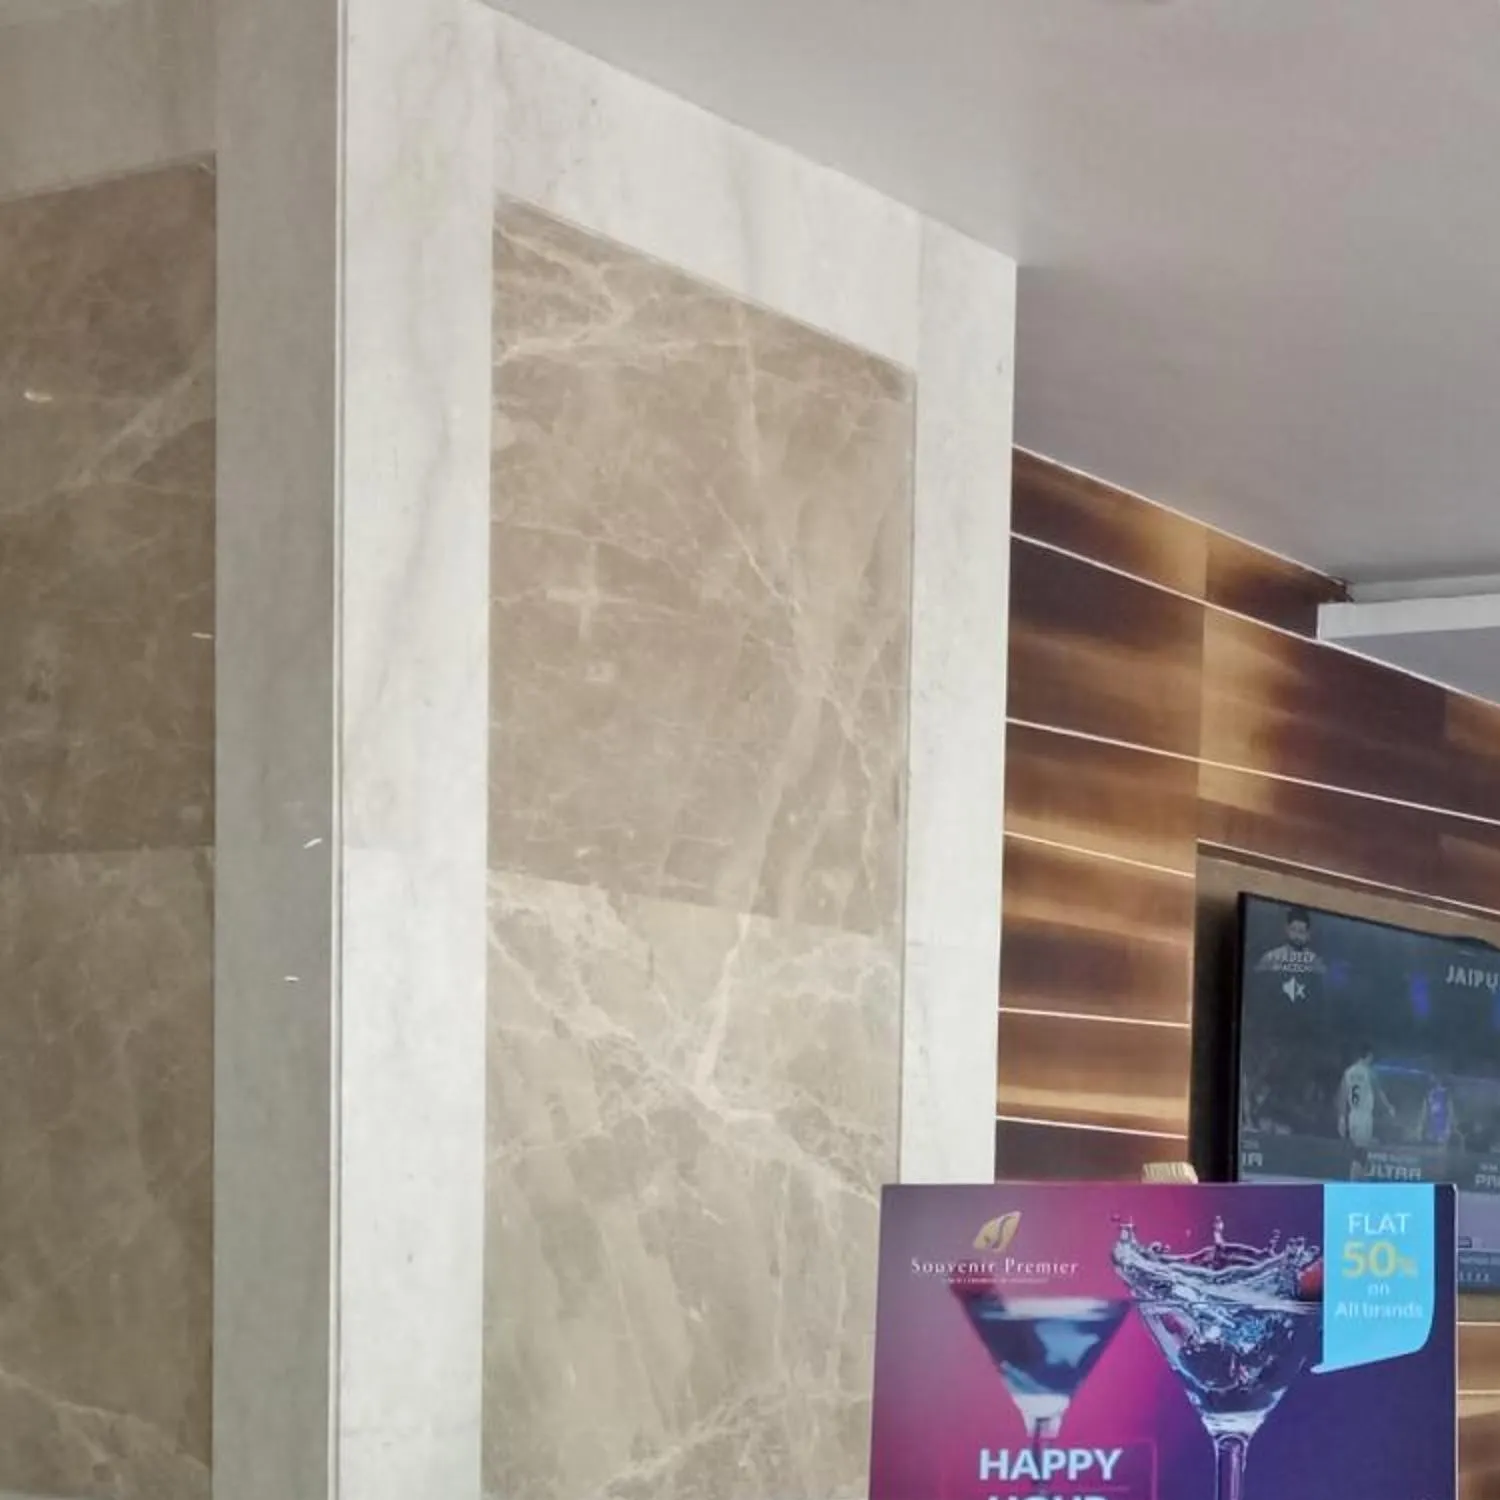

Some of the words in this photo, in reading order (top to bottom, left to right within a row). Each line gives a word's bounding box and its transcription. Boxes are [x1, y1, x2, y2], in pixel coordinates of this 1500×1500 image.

[1348, 1212, 1412, 1235] FLAT
[911, 1256, 996, 1274] Souvenir
[1004, 1256, 1079, 1275] Premier
[1367, 1284, 1390, 1297] on
[1334, 1301, 1359, 1319] All
[1362, 1301, 1424, 1319] brands
[978, 1449, 1123, 1481] HAPPY
